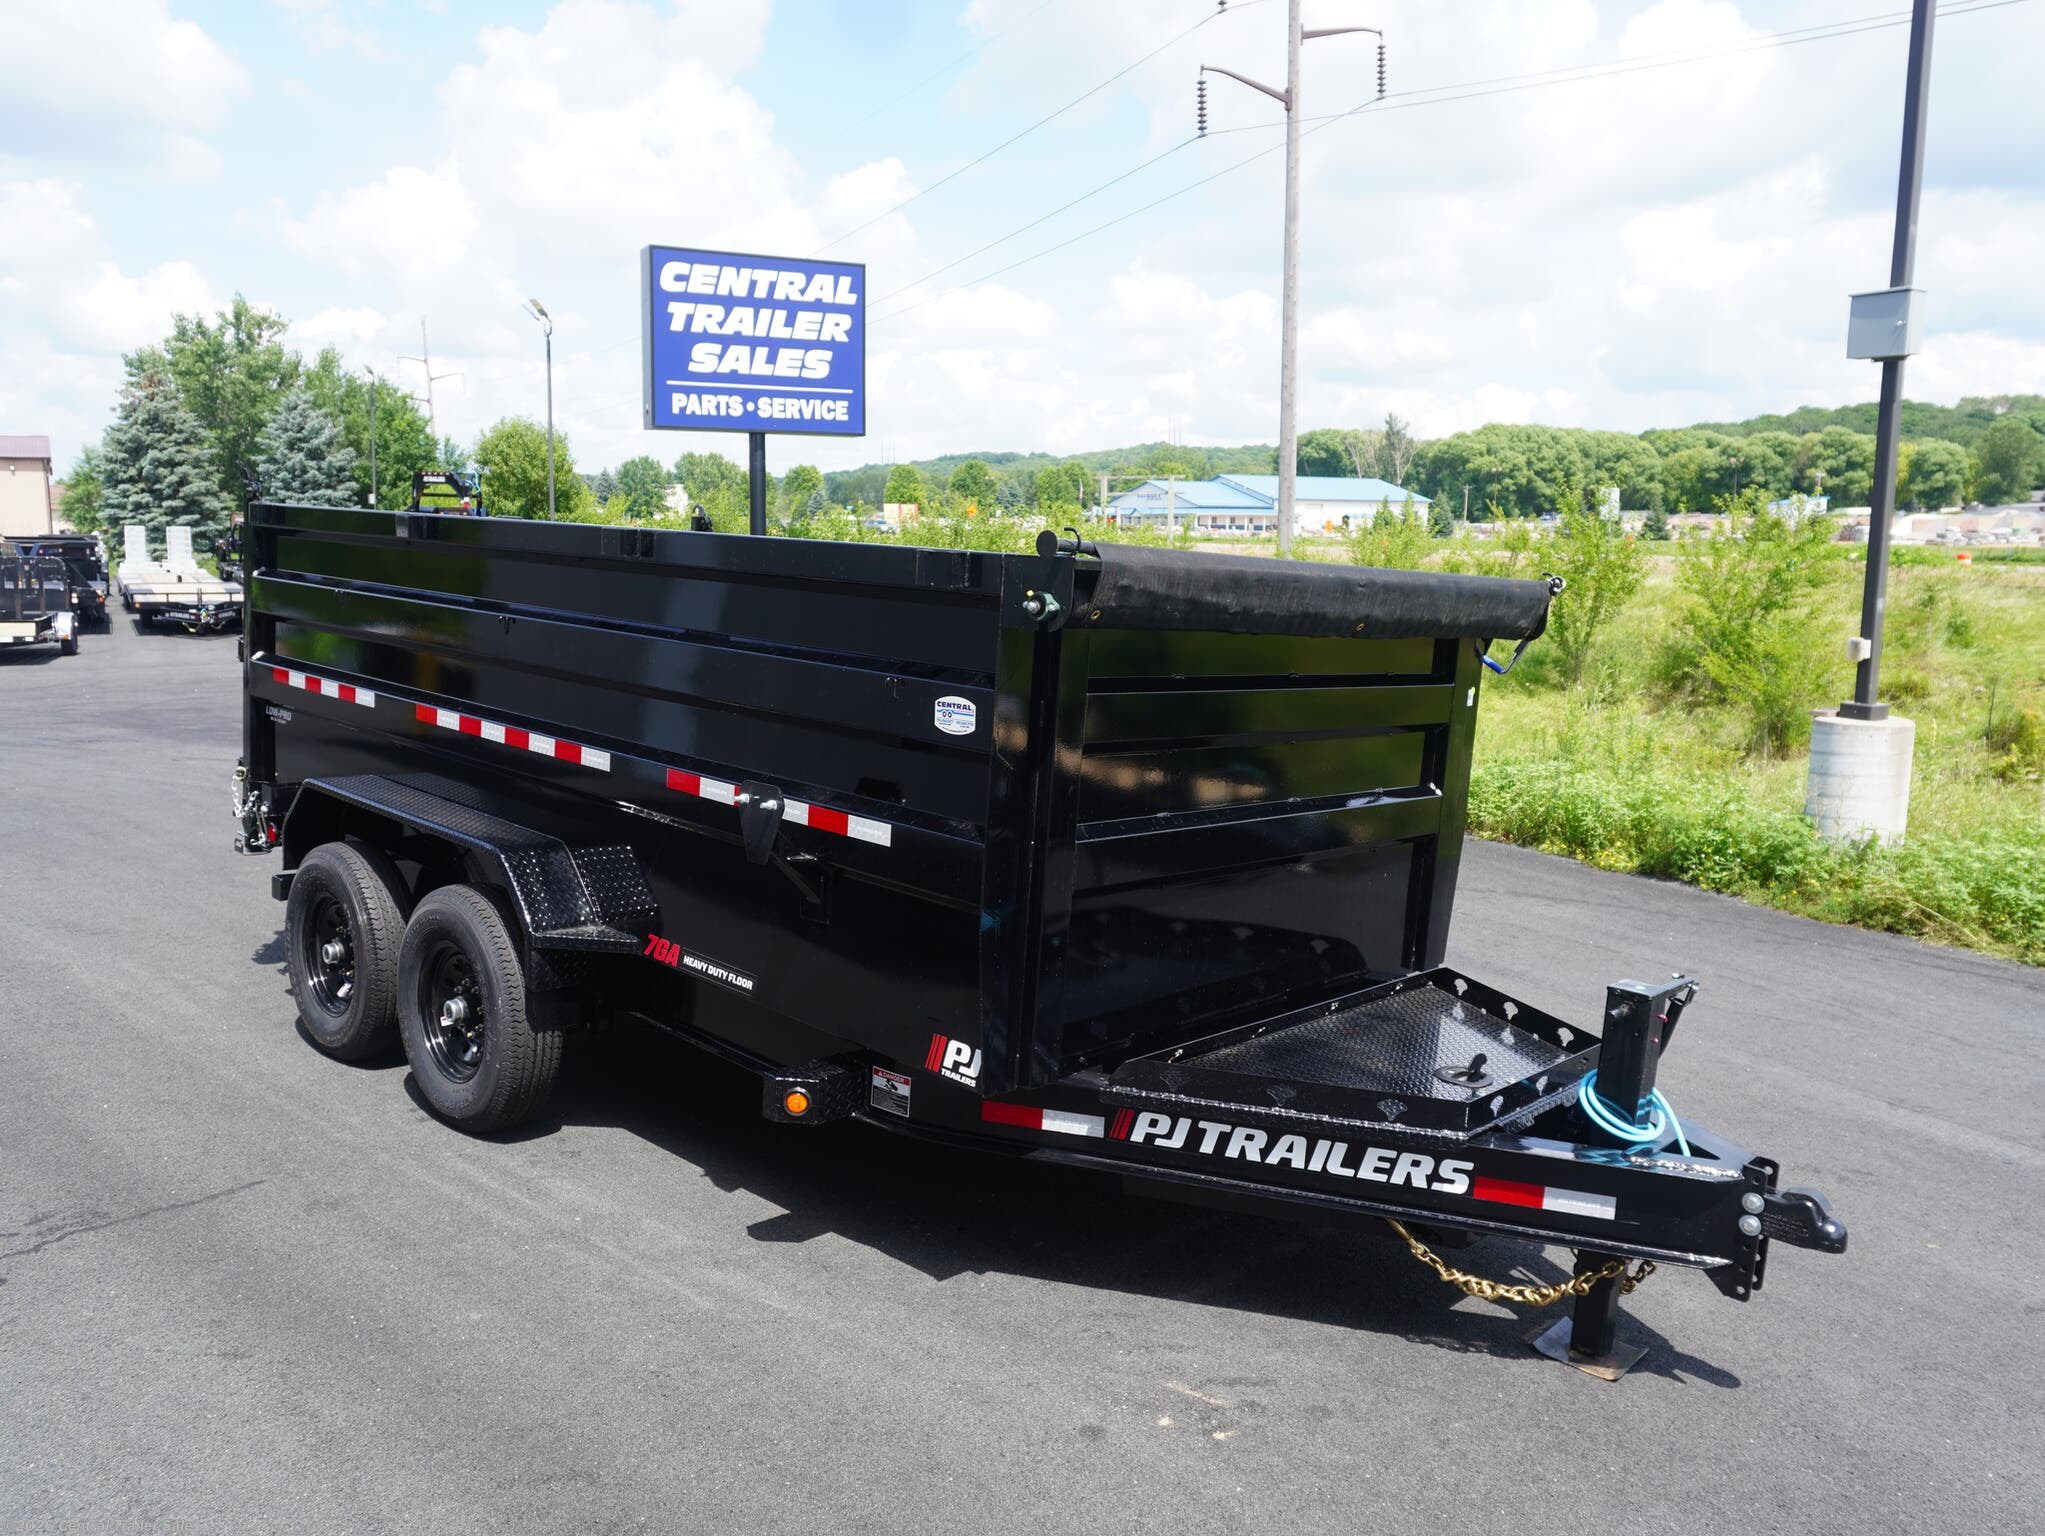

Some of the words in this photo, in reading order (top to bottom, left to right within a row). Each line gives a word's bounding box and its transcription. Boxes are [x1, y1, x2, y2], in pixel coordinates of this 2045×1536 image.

[659, 261, 857, 305] CENTRAL
[667, 301, 852, 342] TRAILER
[688, 342, 833, 379] SALES
[672, 393, 744, 417] PARTS
[757, 397, 849, 421] SERVICE
[936, 701, 972, 711] CENTRAL
[643, 933, 681, 968] 7GA
[683, 955, 708, 972] HEAVY
[707, 965, 729, 980] DUTY
[728, 973, 753, 991] FLOOR
[941, 1068, 977, 1088] TRAILERS
[942, 1039, 982, 1078] PJ
[1129, 1110, 1192, 1149] PJ
[1198, 1122, 1475, 1195] TRAILERS
